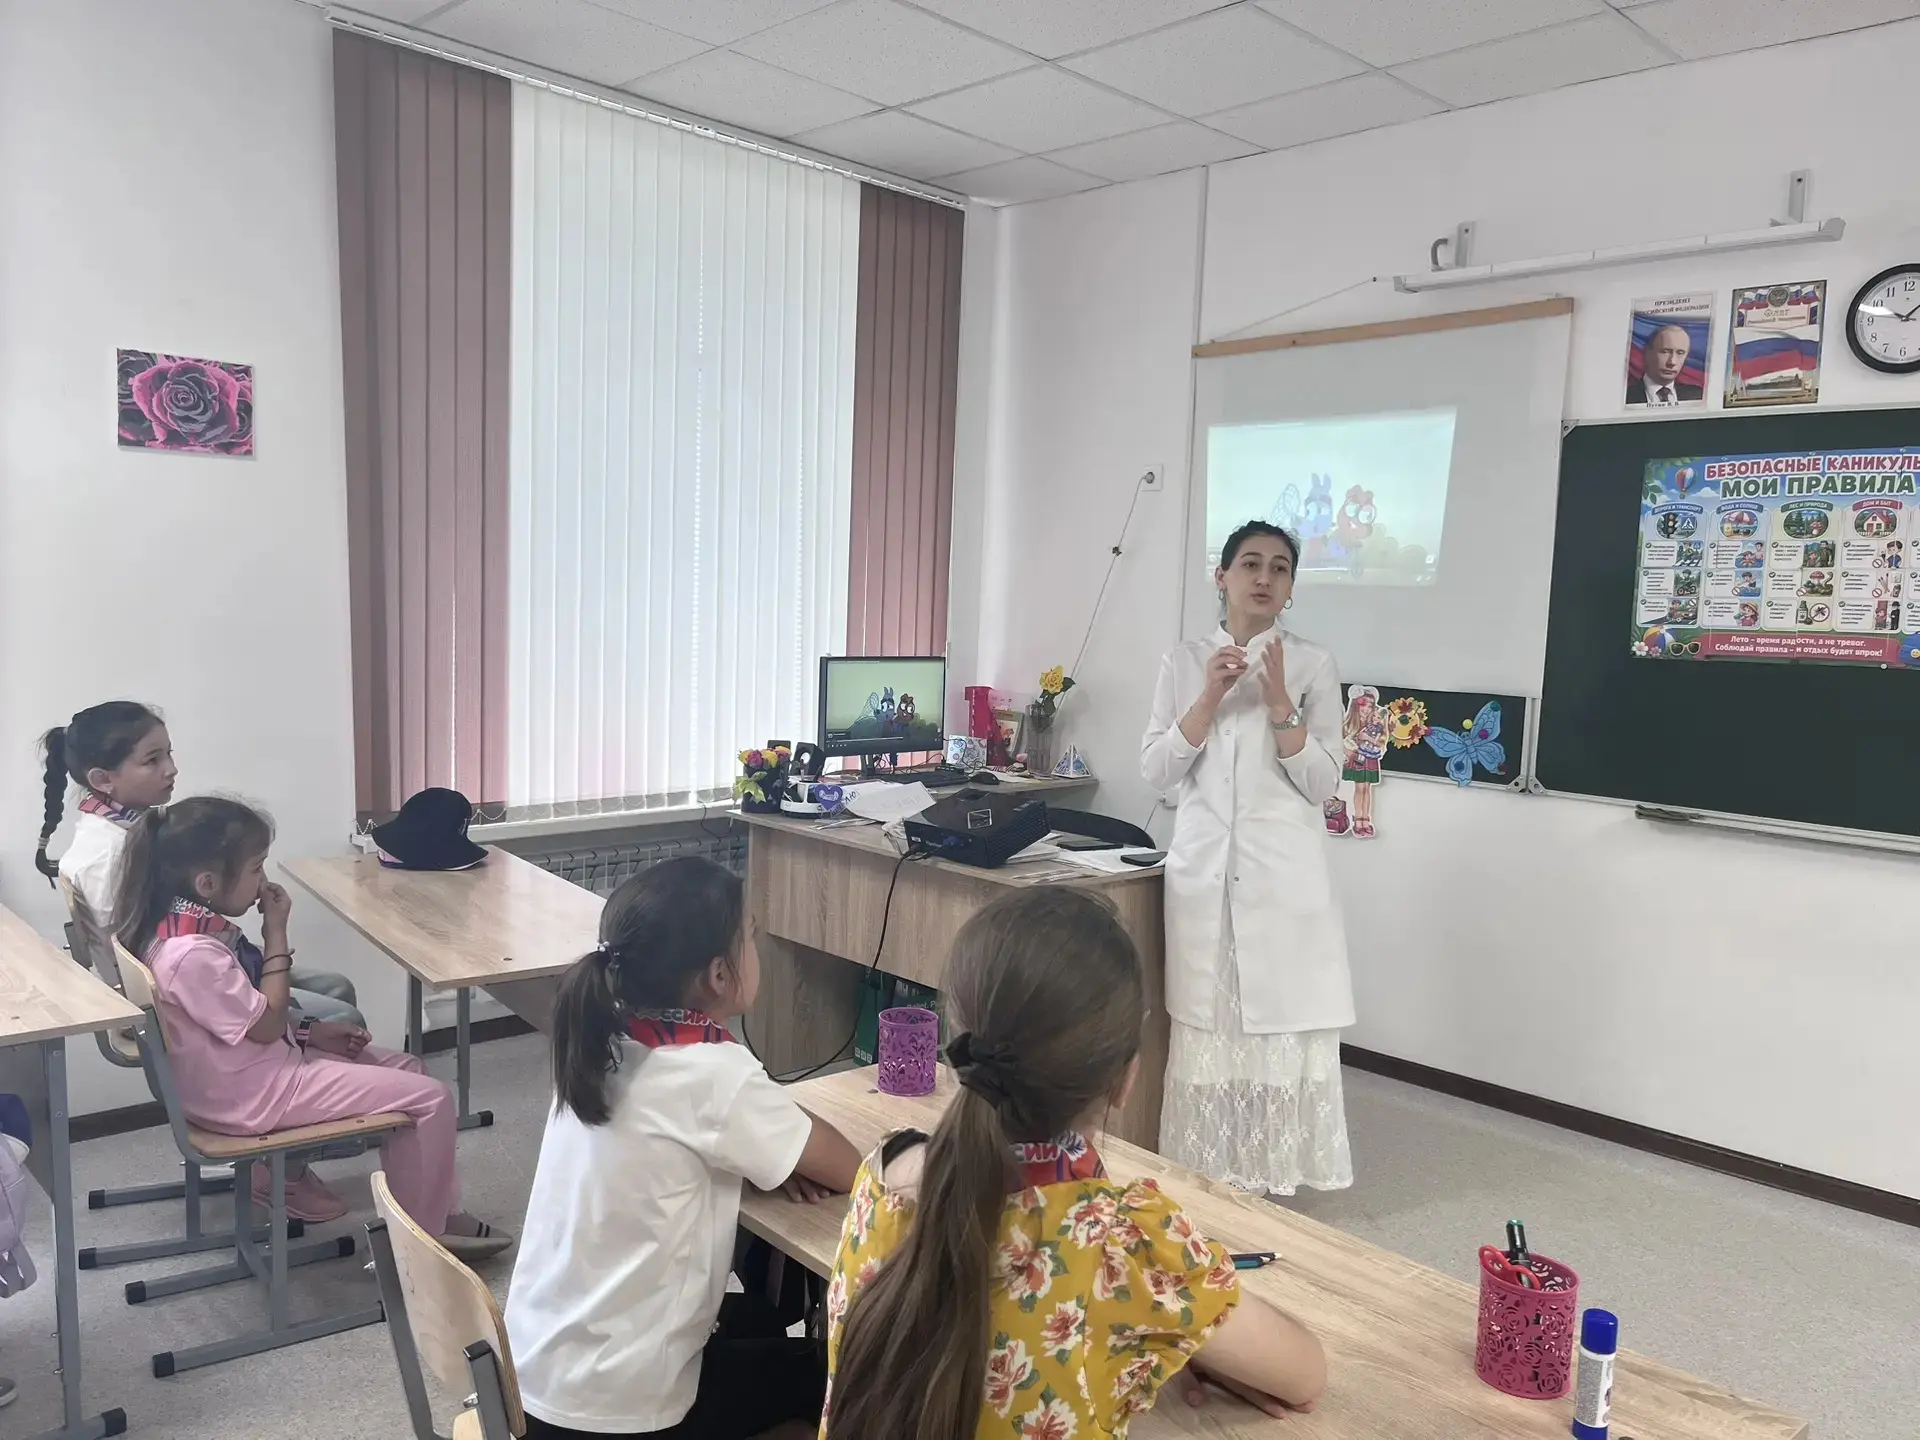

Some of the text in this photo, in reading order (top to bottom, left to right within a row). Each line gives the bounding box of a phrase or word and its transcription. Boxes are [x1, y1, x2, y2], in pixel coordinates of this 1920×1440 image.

[1903, 281, 1915, 292] 12
[1886, 287, 1895, 298] 11
[1872, 300, 1883, 308] 10
[1867, 316, 1874, 326] 9
[1870, 333, 1877, 342] 8
[1882, 343, 1889, 353] 7
[1899, 347, 1907, 356] 6
[1706, 458, 1820, 478] БЕЗОПАСНЫЕ
[1722, 475, 1914, 498] МОИ ПРАВИЛА
[1730, 635, 1749, 643] Лето
[1756, 637, 1780, 645] время
[1714, 643, 1754, 652] Соблюдай
[1830, 647, 1853, 656] будет
[1855, 649, 1883, 657] впрок!
